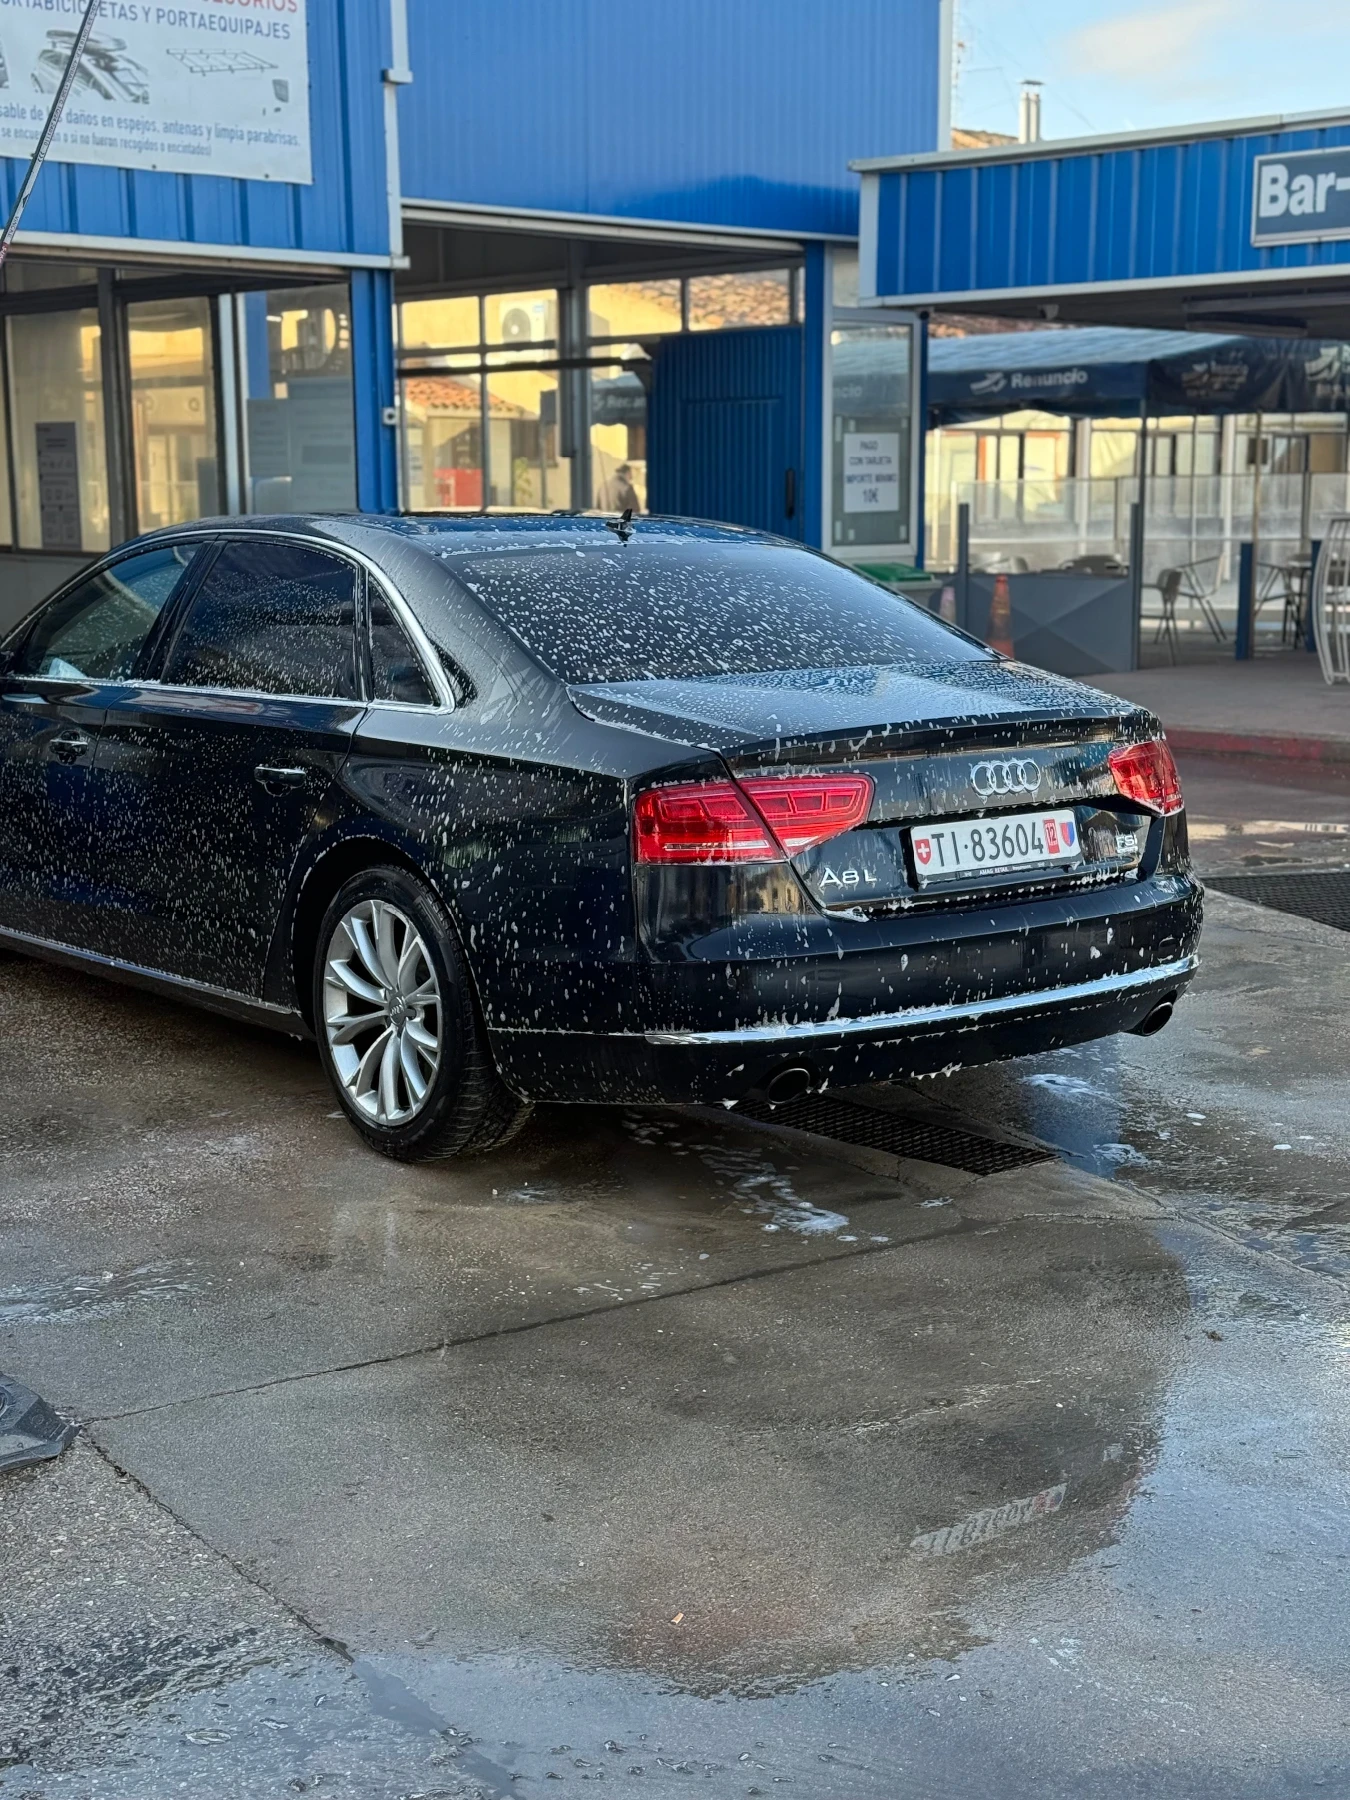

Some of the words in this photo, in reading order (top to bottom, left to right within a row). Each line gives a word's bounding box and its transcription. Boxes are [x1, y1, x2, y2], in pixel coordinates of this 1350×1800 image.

[141, 6, 150, 23] Y
[156, 8, 290, 40] PORTAEQUIPAJES
[30, 104, 43, 121] de
[66, 108, 98, 126] daños
[101, 117, 114, 129] en
[163, 120, 204, 137] antenas
[206, 124, 212, 141] y
[215, 122, 244, 143] limpia
[1011, 368, 1088, 389] Renuncio
